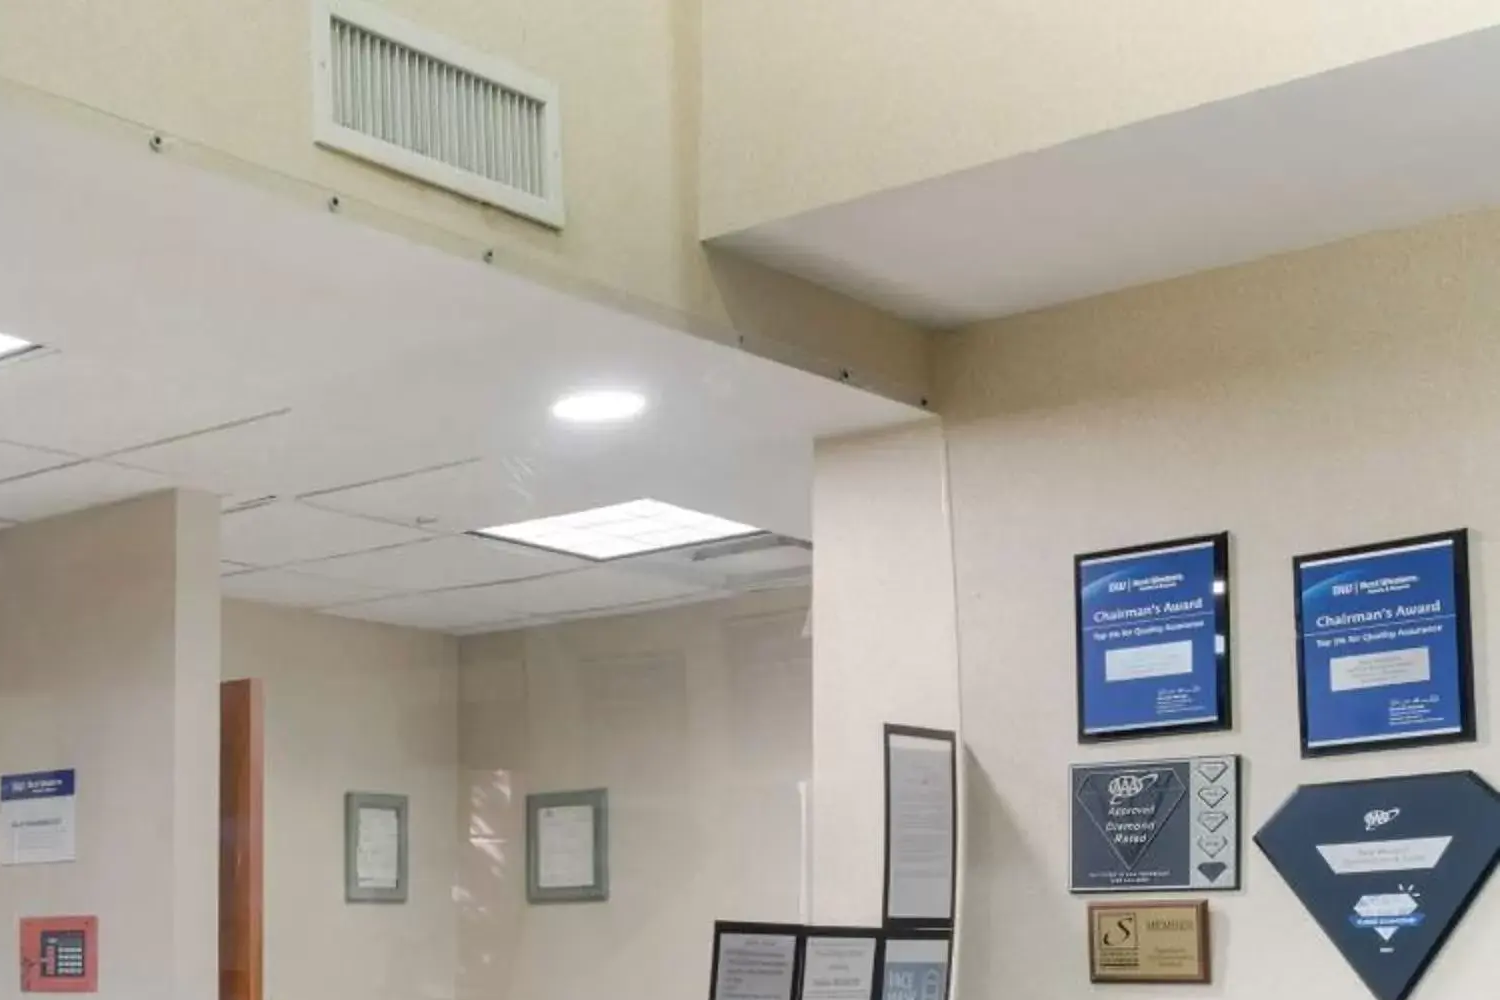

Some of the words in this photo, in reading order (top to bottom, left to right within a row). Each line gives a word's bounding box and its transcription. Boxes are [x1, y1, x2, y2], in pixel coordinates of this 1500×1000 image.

[1093, 603, 1161, 623] Chairman's
[1163, 597, 1203, 613] Award
[1316, 607, 1393, 628] Chairman's
[1395, 600, 1441, 616] Award
